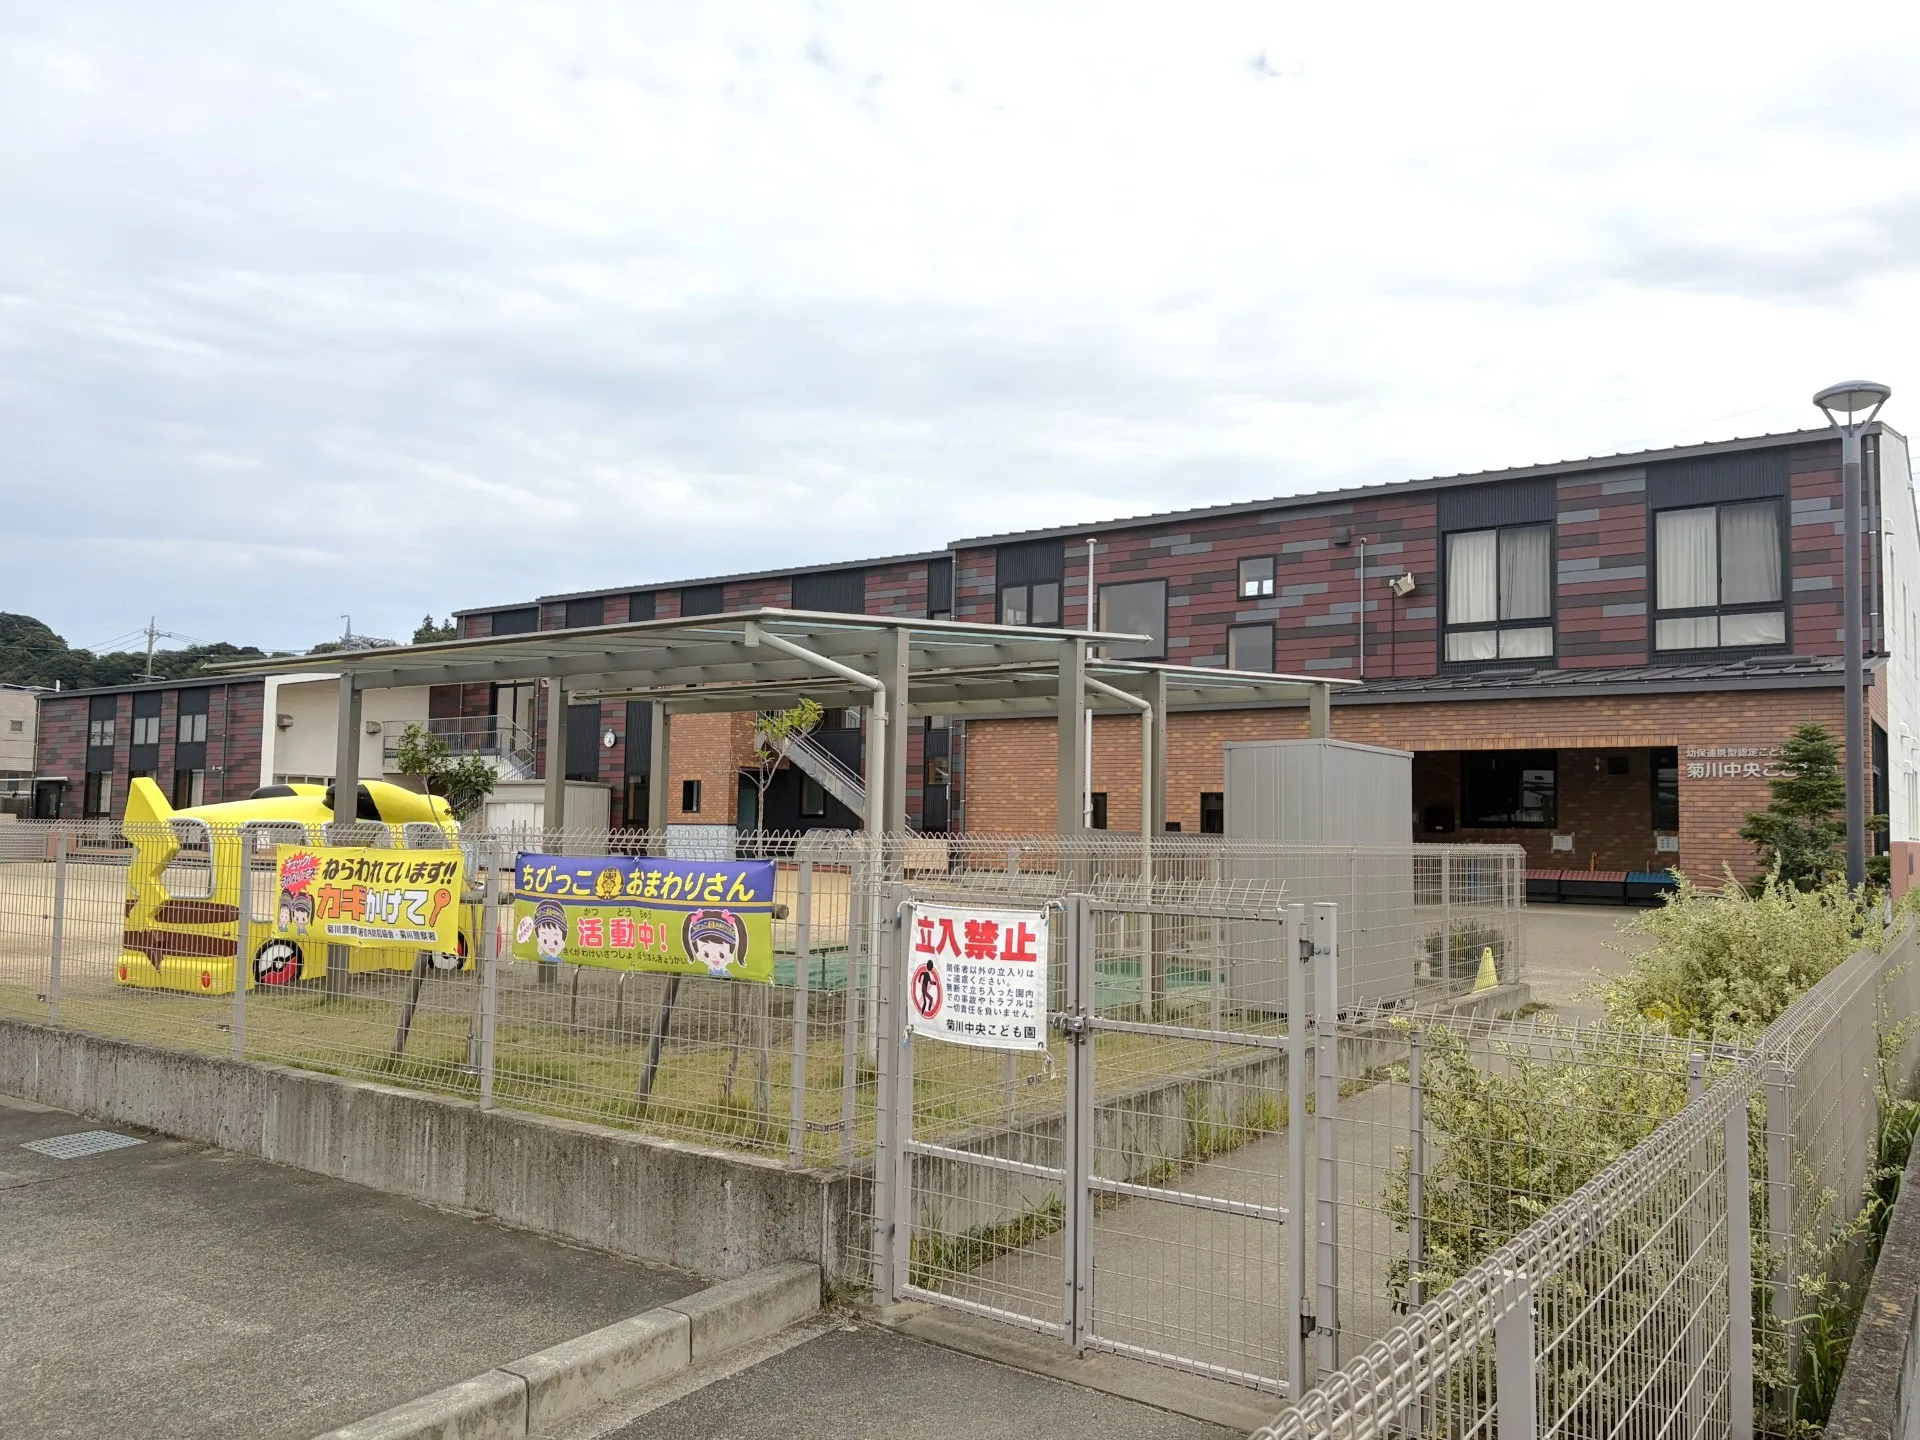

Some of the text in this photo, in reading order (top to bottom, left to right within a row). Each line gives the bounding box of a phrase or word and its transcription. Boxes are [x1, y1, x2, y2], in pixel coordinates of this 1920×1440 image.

[1686, 748, 1799, 758] 幼保連携型認定こども
[322, 858, 458, 885] ねらわれています!!
[522, 864, 755, 902] ちびっこ おまわりさん
[316, 883, 429, 926] カギかけて
[583, 908, 599, 917] かつ
[617, 908, 632, 917] どう
[915, 916, 1037, 962] 立入禁止
[946, 963, 1034, 978] 関係者以外の立入りは
[946, 975, 1010, 987] ご遠慮ください。
[946, 984, 1034, 999] 無断で立ち入った園内
[946, 994, 1034, 1009] での事故やトラブルは
[946, 1004, 1035, 1019] 一切責任を負いません。
[946, 1019, 1036, 1039] 菊川中央こども園
